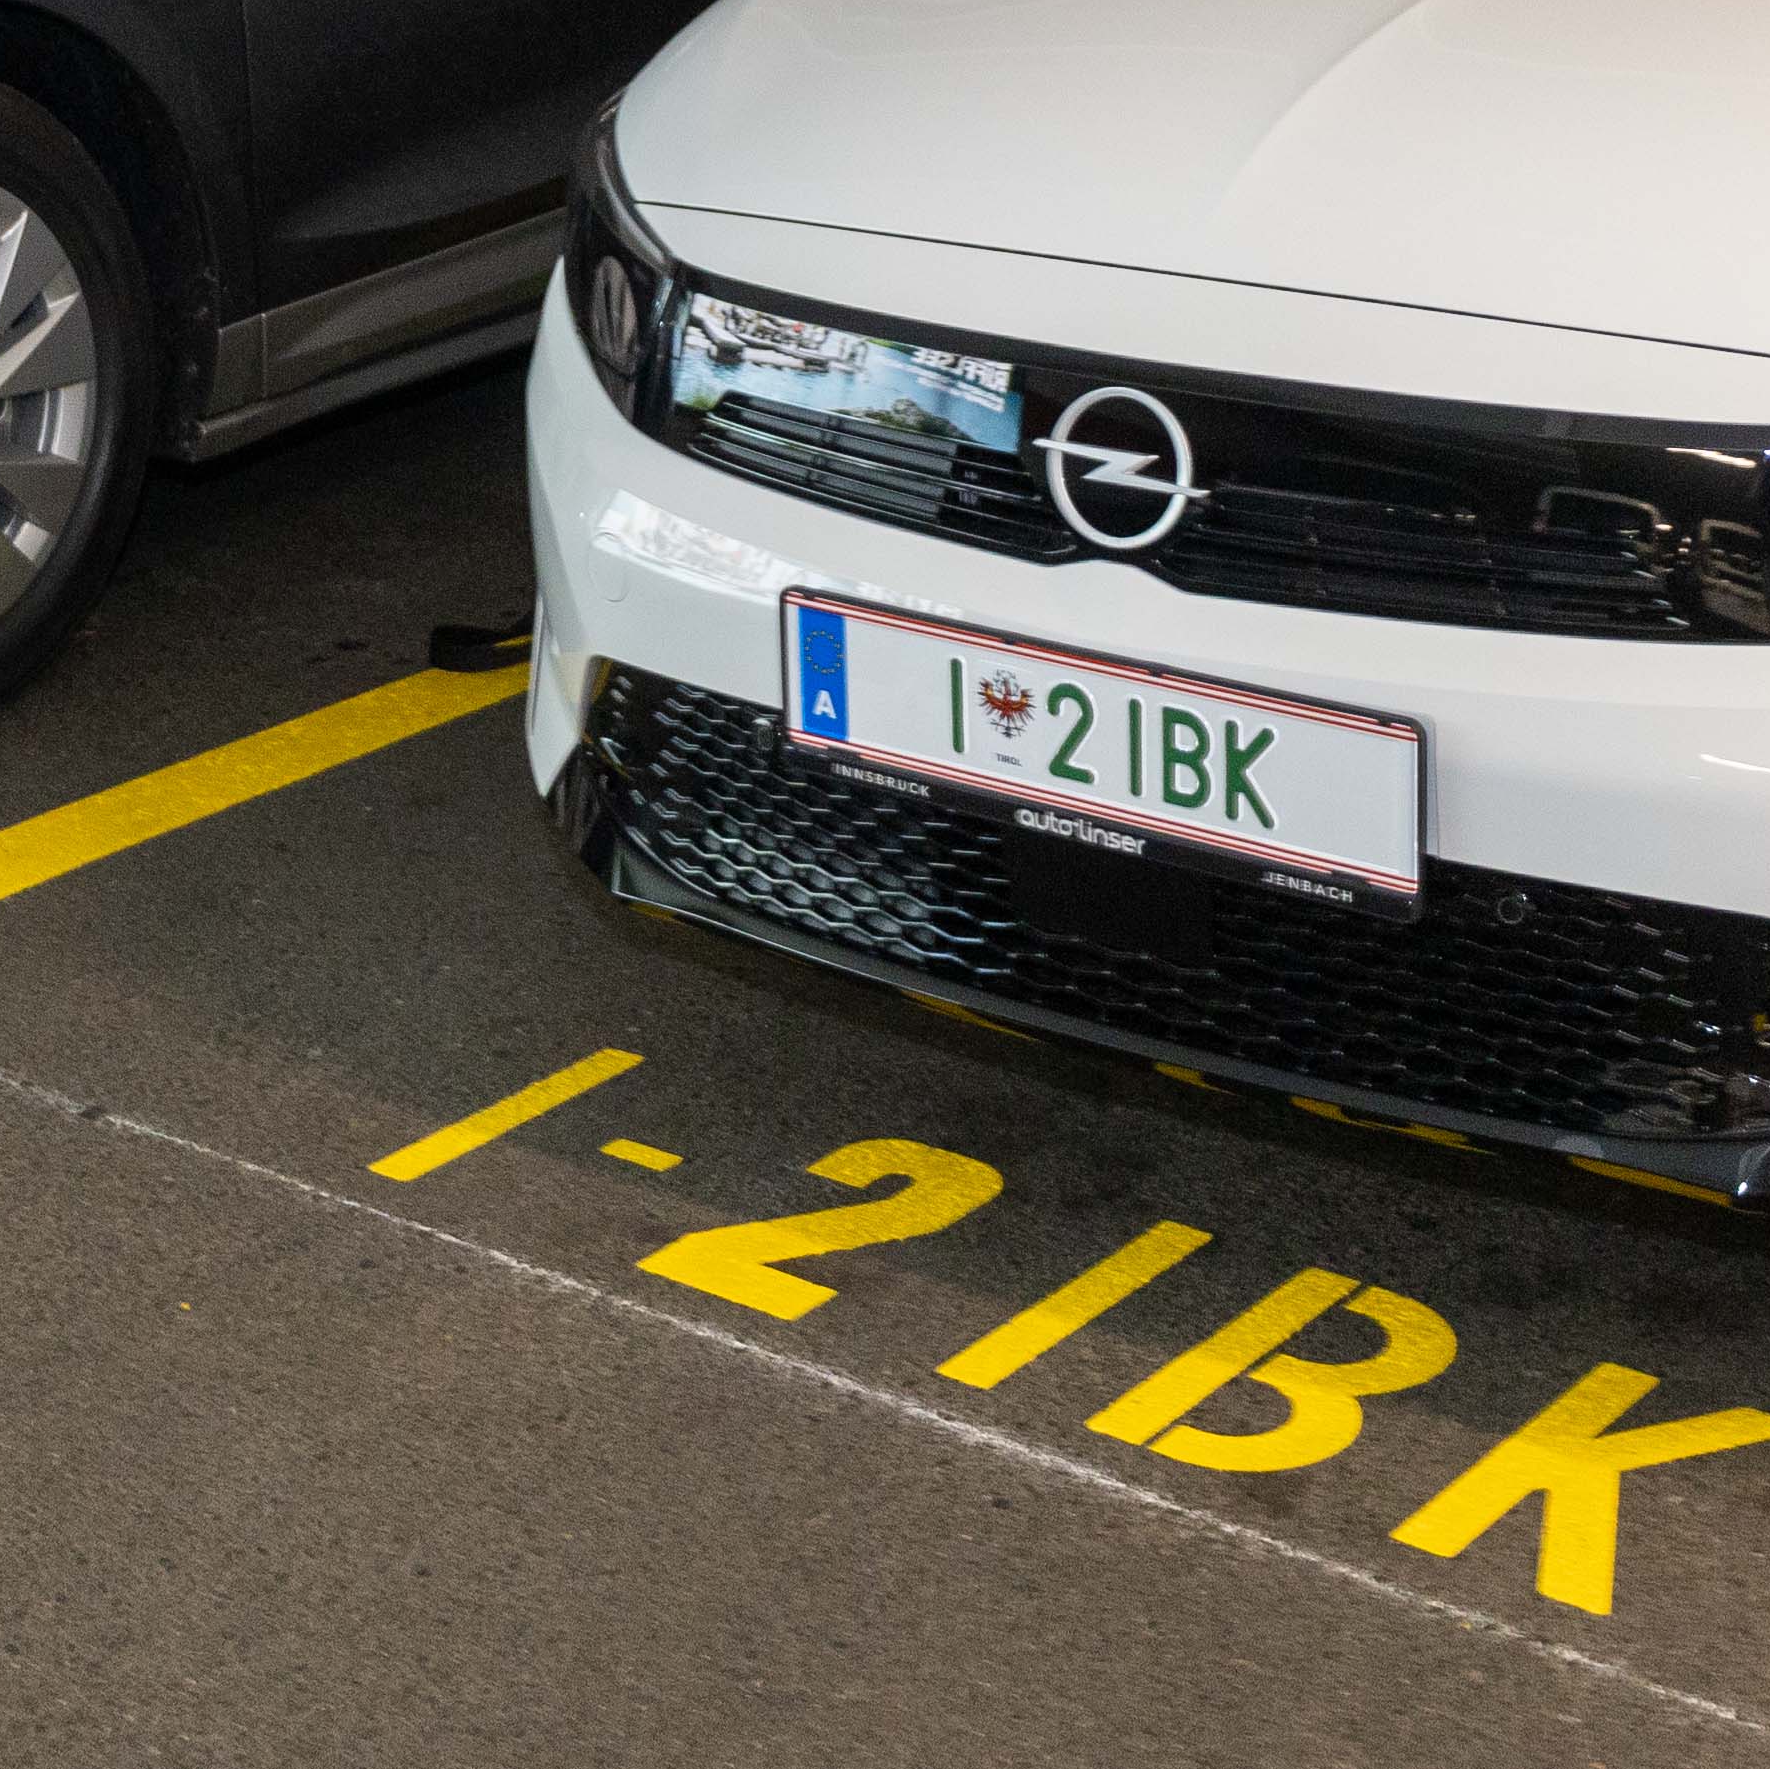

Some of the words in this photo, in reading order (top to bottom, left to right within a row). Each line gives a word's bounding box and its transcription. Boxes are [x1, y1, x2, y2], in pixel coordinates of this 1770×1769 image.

[811, 690, 838, 720] A
[832, 762, 930, 797] INNSBRUCK
[1262, 872, 1353, 904] JENBACH
